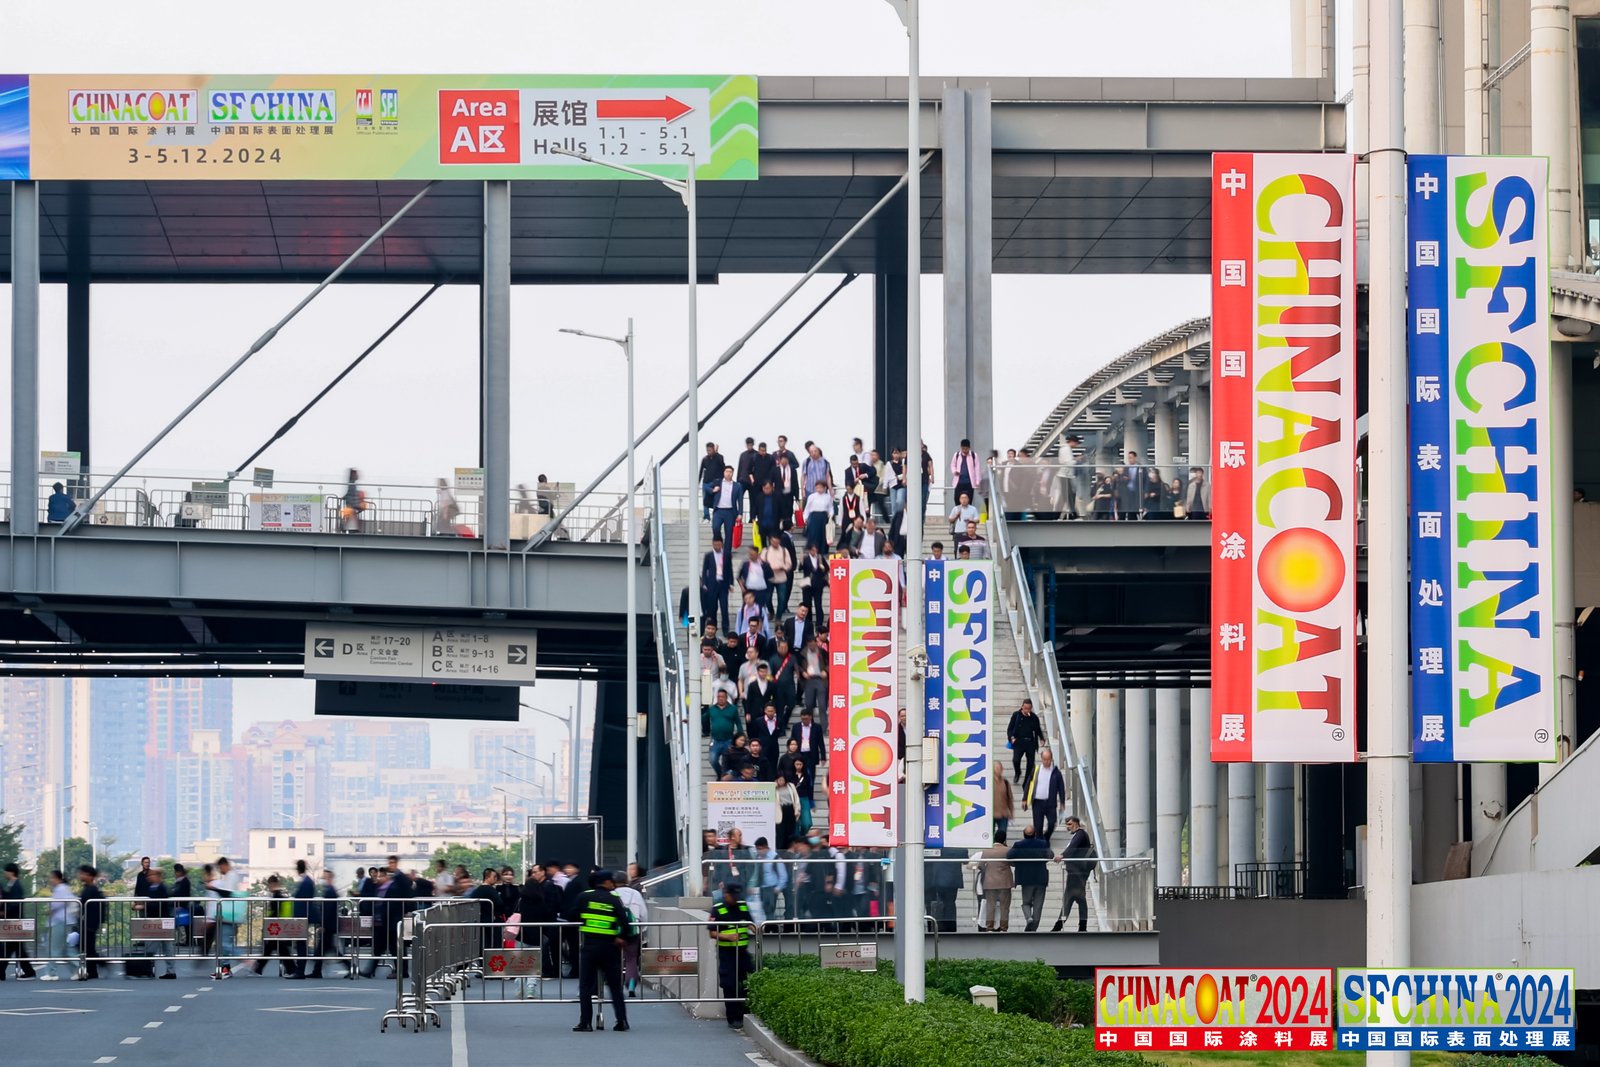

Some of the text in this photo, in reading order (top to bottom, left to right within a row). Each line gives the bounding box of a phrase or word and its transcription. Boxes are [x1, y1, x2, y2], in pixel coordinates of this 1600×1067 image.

[72, 91, 191, 122] CHINACOAT
[451, 98, 506, 117] Area
[533, 100, 588, 127] 展馆
[71, 126, 195, 136] 中国国际涂料展
[210, 126, 334, 136] 中国国际表面处理展
[599, 127, 626, 139] 1.1
[659, 127, 687, 139] 5.1
[450, 126, 506, 153] A区
[534, 137, 588, 155] Halls
[128, 148, 282, 164] 3-5.12.2024
[599, 142, 628, 156] 1.2
[659, 142, 690, 156] 5.2
[1219, 168, 1247, 742] 中国国际涂料展
[1255, 173, 1346, 726] CHINACOAT
[1455, 171, 1541, 728] SFCHINA
[1415, 172, 1445, 742] 中国国际表面处理展
[384, 636, 411, 646] 17-20
[432, 631, 444, 642] A
[473, 634, 489, 643] 1-8
[343, 643, 353, 655] D
[356, 643, 365, 651] 区
[432, 645, 442, 657] B
[472, 649, 495, 659] 9-13
[432, 660, 442, 672] C
[472, 665, 499, 675] 14-16
[832, 566, 847, 837] 中国国际涂料展
[851, 568, 893, 830] CHINACOAT
[927, 568, 941, 839] 中国国际表面理展
[947, 568, 987, 832] SFCHINA
[657, 954, 682, 963] CFTC
[835, 950, 861, 958] CFTC
